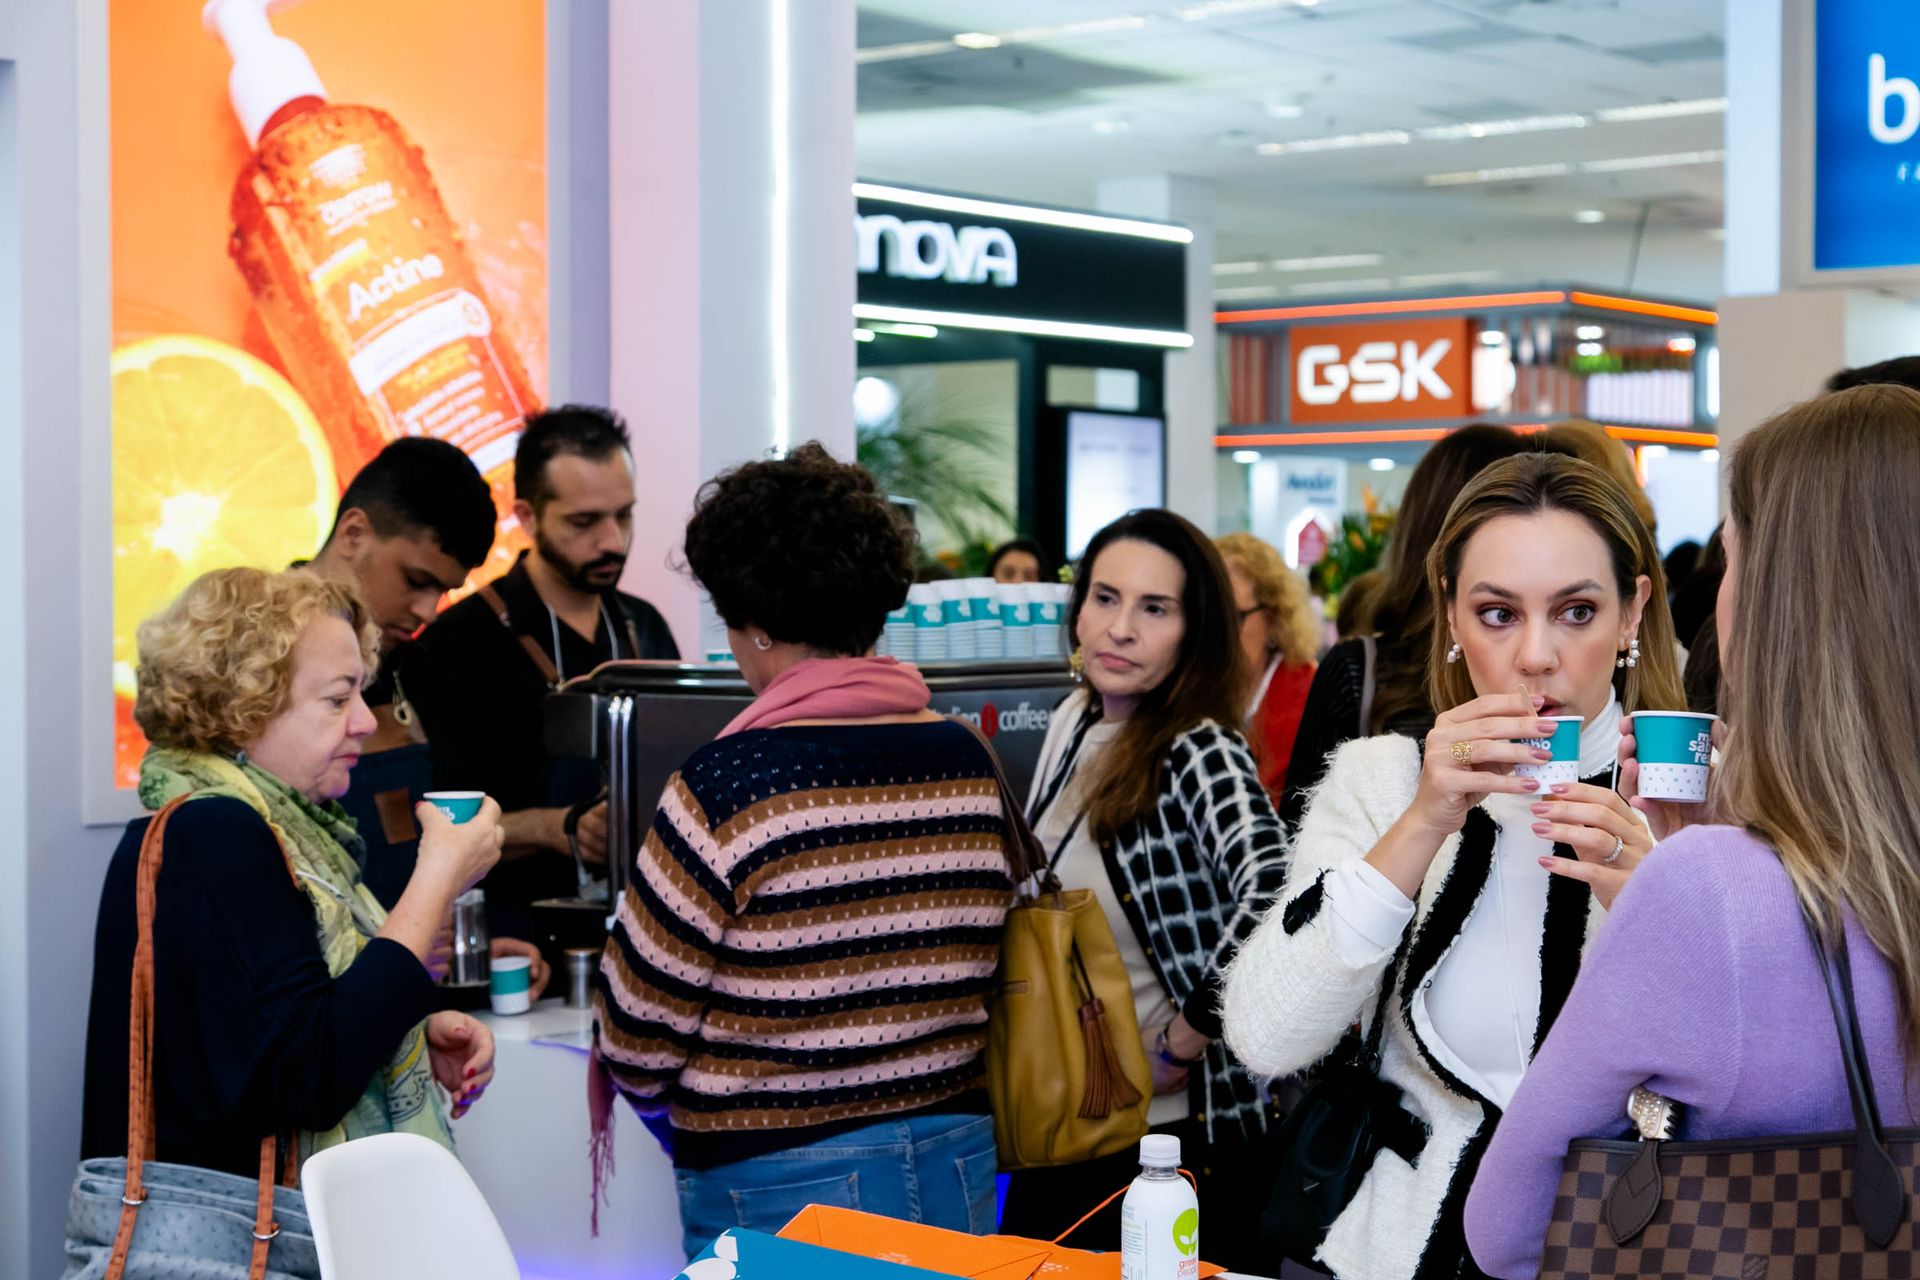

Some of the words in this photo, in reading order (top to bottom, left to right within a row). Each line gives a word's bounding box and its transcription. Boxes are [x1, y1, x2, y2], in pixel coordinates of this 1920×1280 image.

[347, 253, 444, 322] Actine
[1297, 339, 1453, 405] GSK
[999, 702, 1048, 731] coffee
